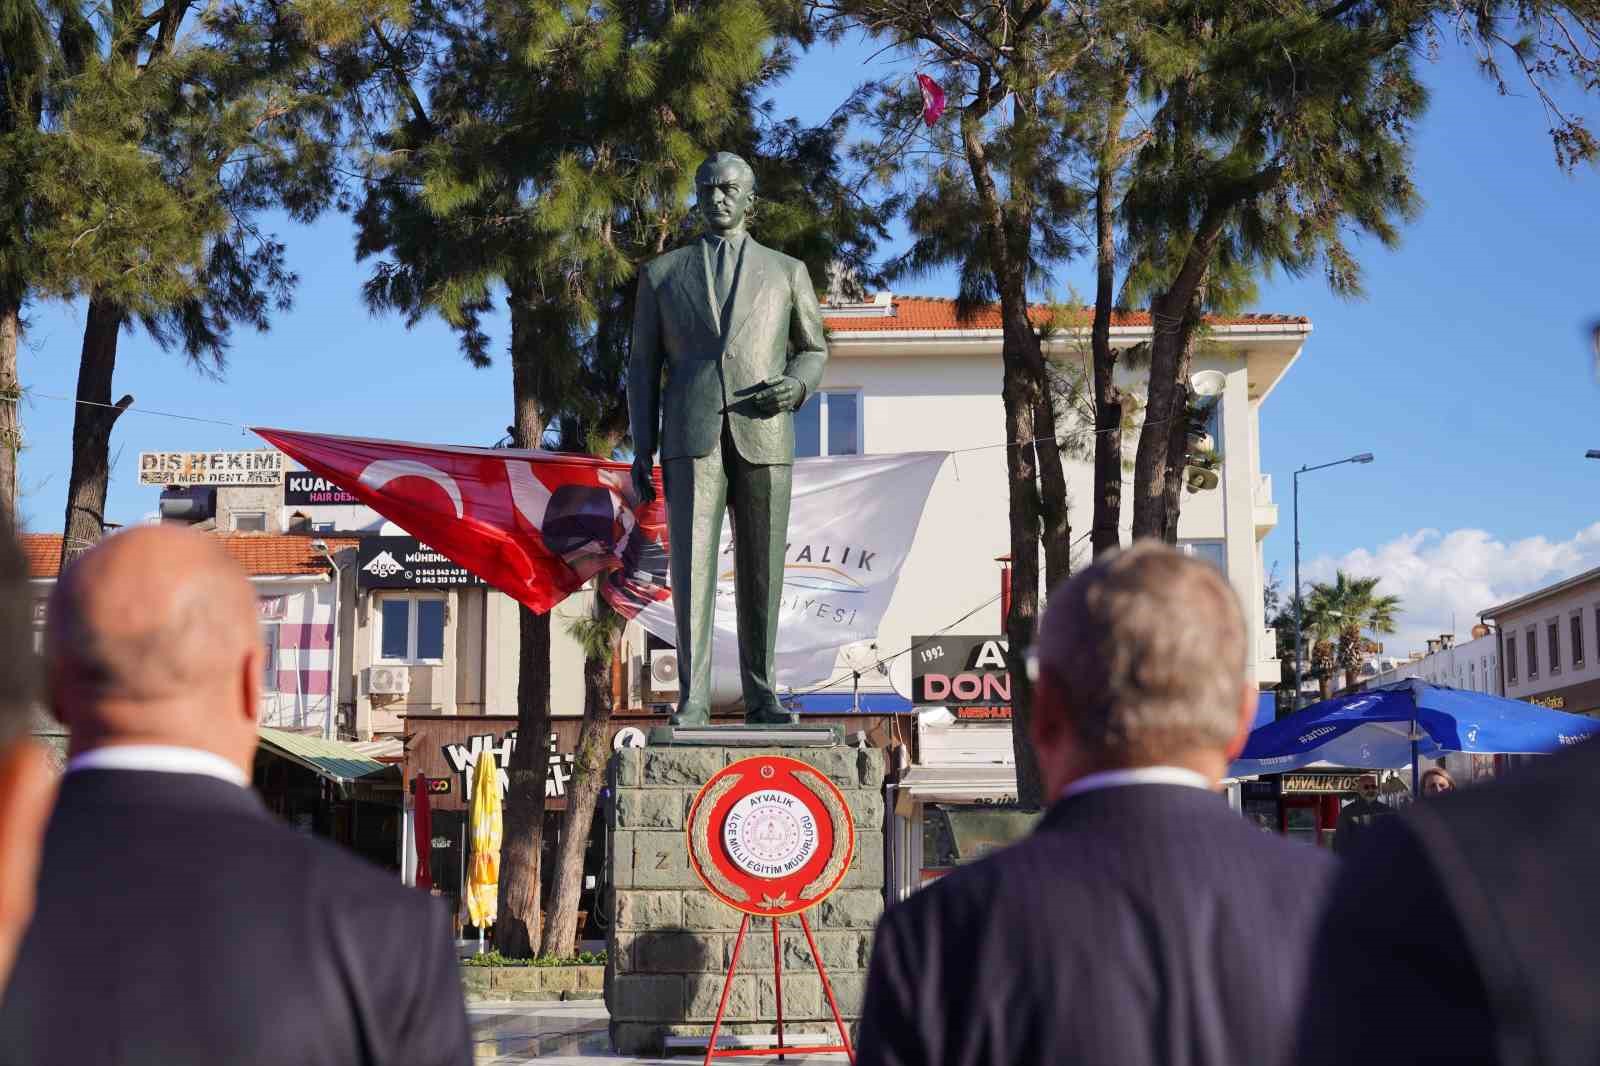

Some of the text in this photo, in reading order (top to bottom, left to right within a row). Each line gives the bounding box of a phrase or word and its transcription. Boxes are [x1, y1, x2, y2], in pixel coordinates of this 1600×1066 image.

[310, 492, 331, 502] HAIR
[919, 645, 945, 663] 1992
[923, 672, 1012, 700] DON
[1286, 775, 1334, 790] AYVALIK
[750, 794, 793, 809] AYVALIK
[728, 812, 814, 875] İLÇE MİLLİ EĞİTİM MÜDÜRLÜĞÜ
